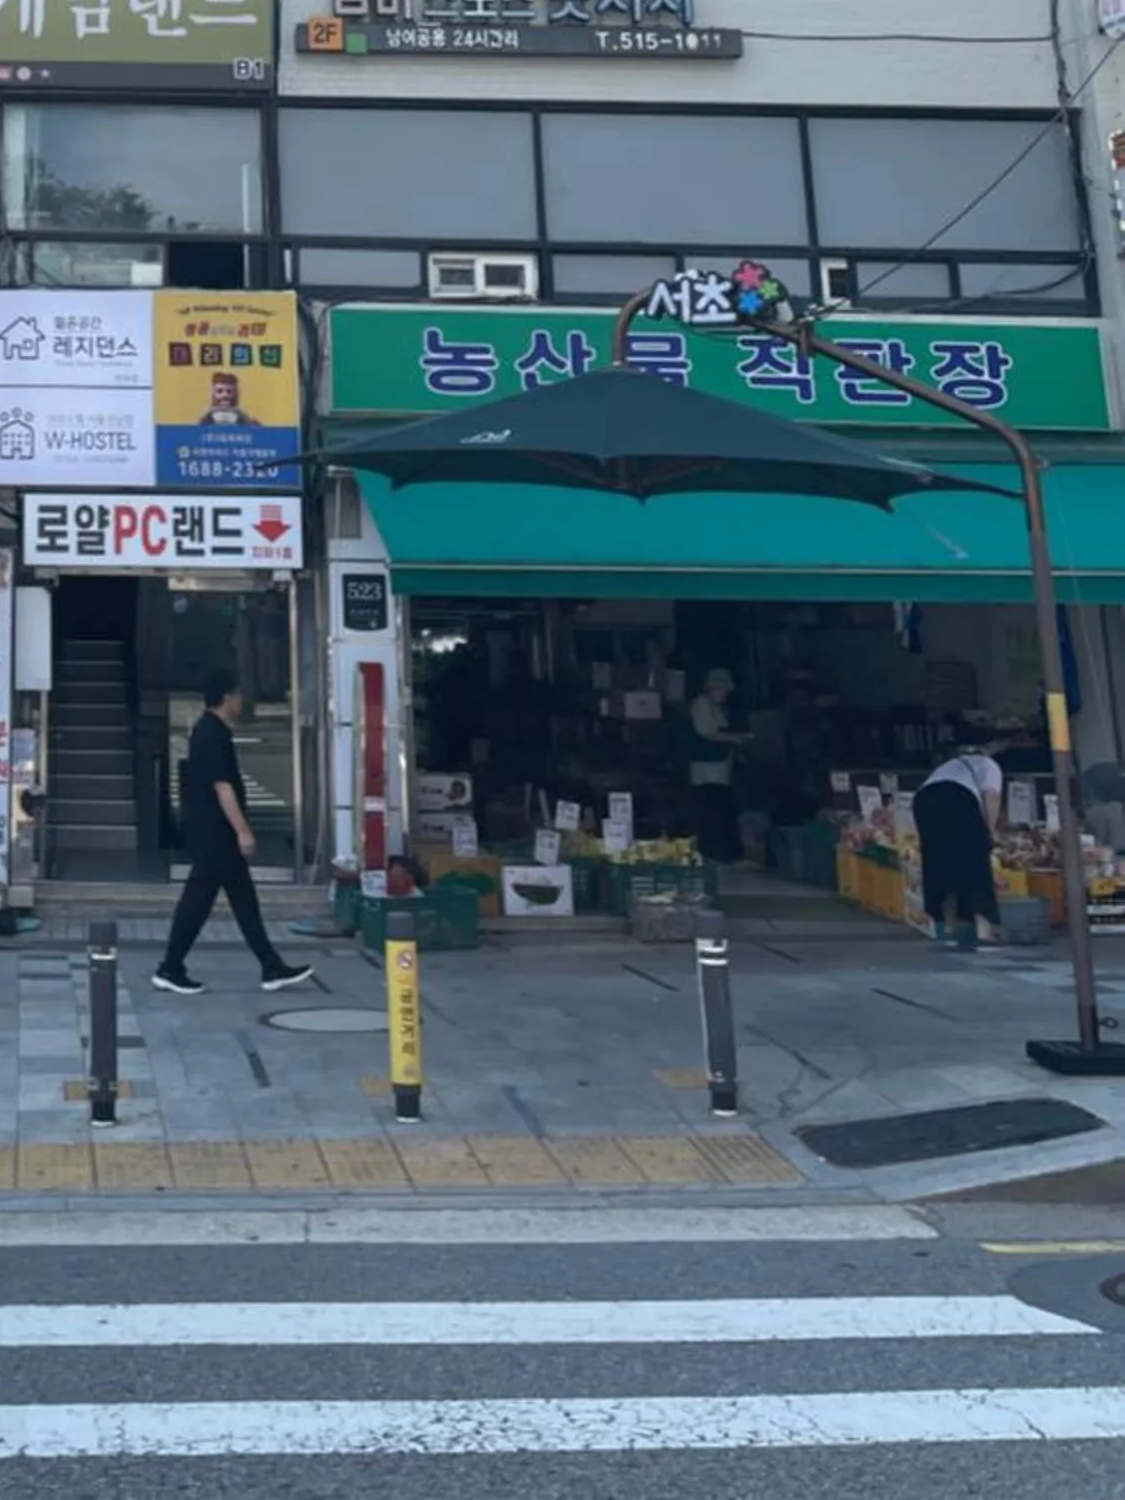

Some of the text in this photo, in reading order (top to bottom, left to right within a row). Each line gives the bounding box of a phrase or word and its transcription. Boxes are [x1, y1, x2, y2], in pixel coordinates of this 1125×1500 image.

[313, 24, 337, 44] 2F
[234, 58, 265, 80] B1
[647, 274, 736, 324] 서초
[52, 336, 138, 359] 레지던스
[739, 333, 1009, 408] 직판장
[44, 430, 137, 452] W-HOSTEL
[36, 504, 245, 557] 로얄PC랜드
[347, 581, 383, 600] 523
